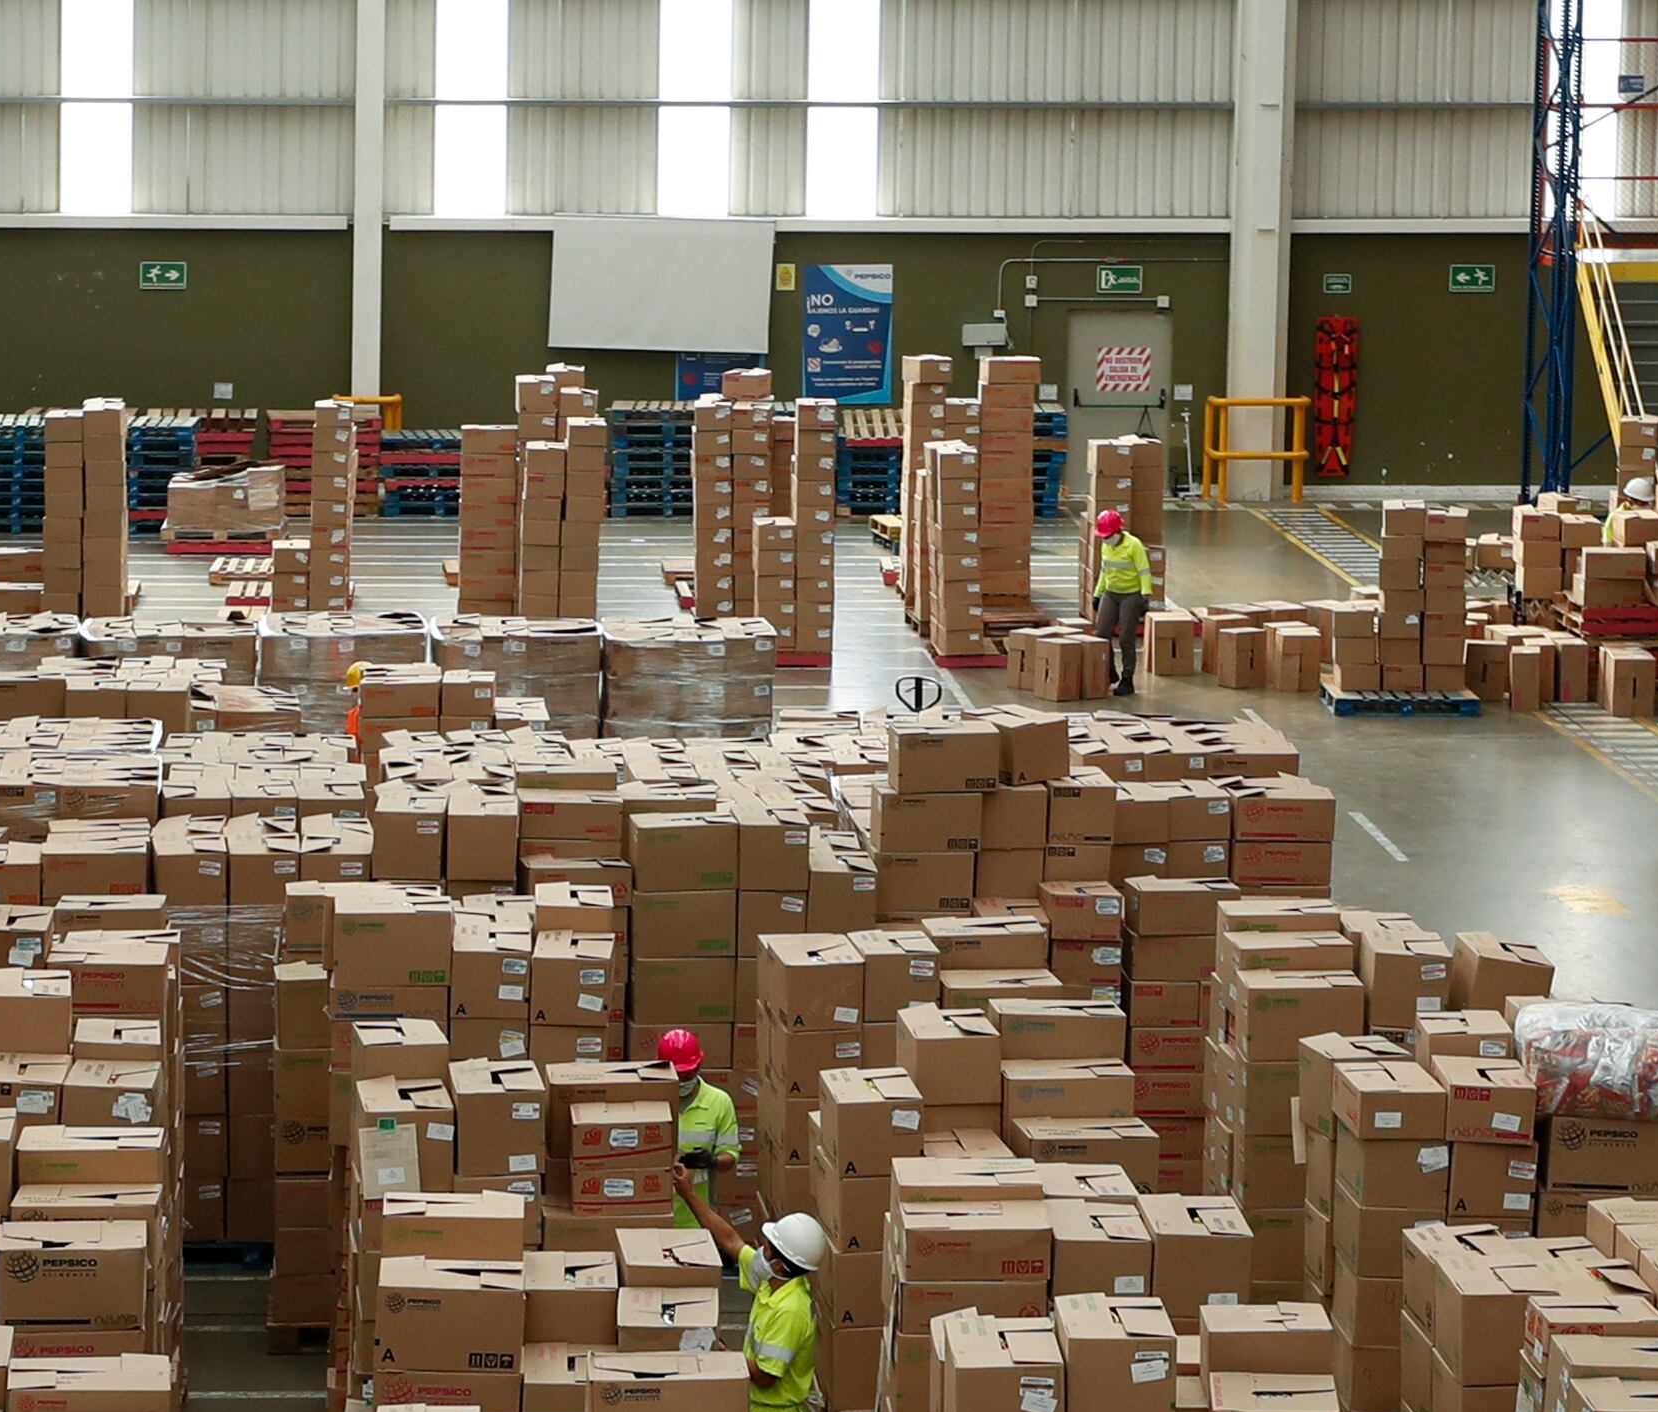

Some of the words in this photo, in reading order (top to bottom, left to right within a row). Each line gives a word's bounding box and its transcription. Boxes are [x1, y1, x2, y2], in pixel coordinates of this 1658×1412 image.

[806, 294, 834, 308] ¡NO
[456, 1004, 467, 1015] A
[536, 1010, 545, 1021] A
[794, 1015, 803, 1025] A
[1589, 1129, 1637, 1139] PEPSICO
[845, 1161, 856, 1174] A
[1456, 1199, 1466, 1211] A
[42, 1259, 97, 1268] PEPSICO
[842, 1311, 853, 1322] A
[40, 1346, 94, 1354] PEPSICO
[382, 1349, 394, 1362] A
[418, 1387, 471, 1396] PEPSICO
